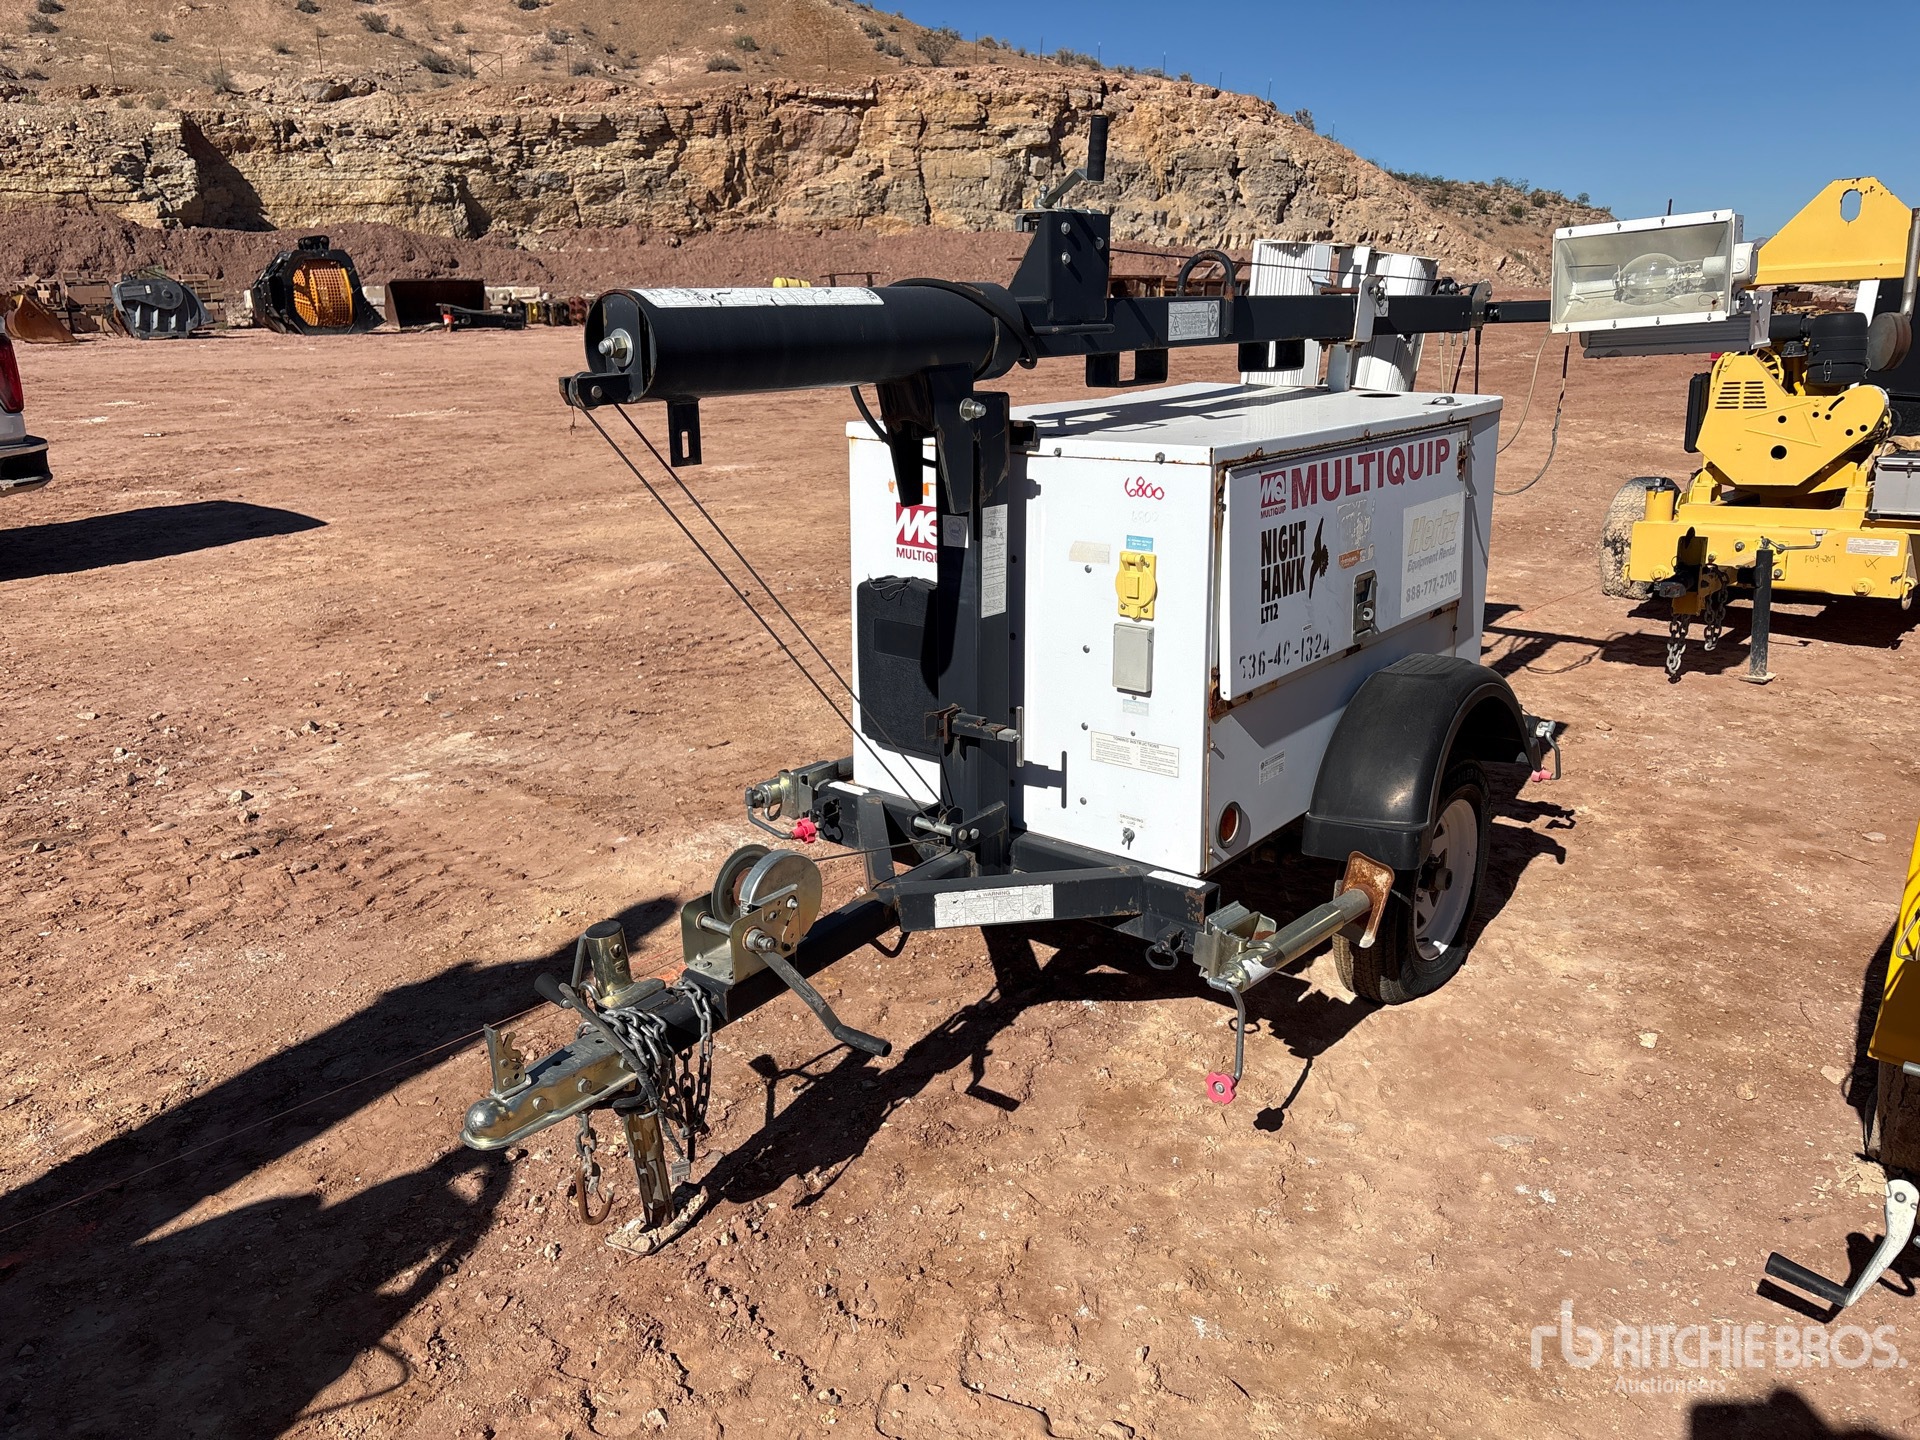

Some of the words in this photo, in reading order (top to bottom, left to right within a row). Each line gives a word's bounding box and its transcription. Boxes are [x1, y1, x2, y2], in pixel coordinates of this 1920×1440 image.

[1124, 476, 1164, 500] 6800
[1291, 438, 1450, 510] MULTIQUIP
[1261, 505, 1286, 519] MULTIQUIP
[1261, 520, 1306, 567] NIGHT
[1407, 509, 1460, 556] Hertz
[1407, 550, 1438, 573] Equipment
[1439, 543, 1456, 560] Rental
[1261, 556, 1306, 604] HAWK
[1406, 570, 1457, 603] 888-777-2700
[1261, 603, 1278, 624] LT12
